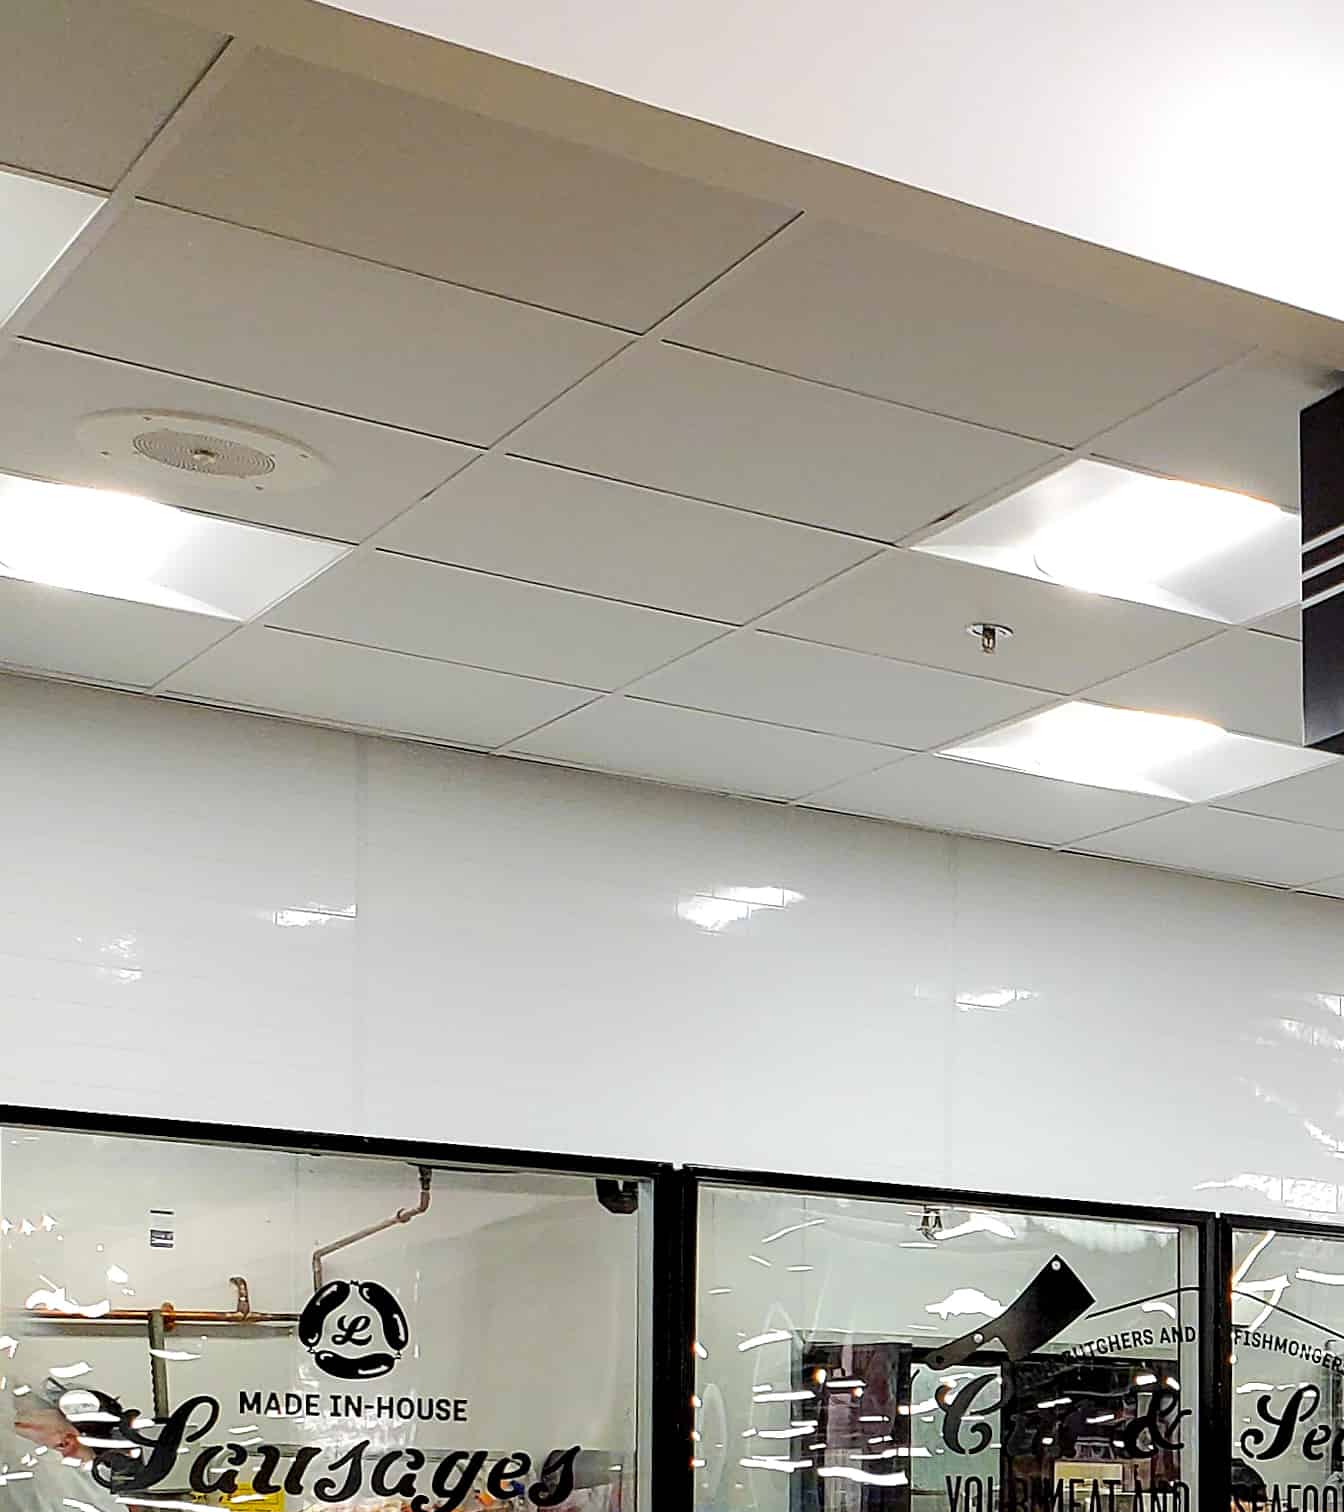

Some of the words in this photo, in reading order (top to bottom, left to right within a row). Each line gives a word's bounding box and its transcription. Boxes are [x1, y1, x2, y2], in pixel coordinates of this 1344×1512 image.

[1160, 1326, 1196, 1343] AND
[239, 1391, 320, 1416] MADE
[330, 1394, 467, 1421] IN-HOUSE
